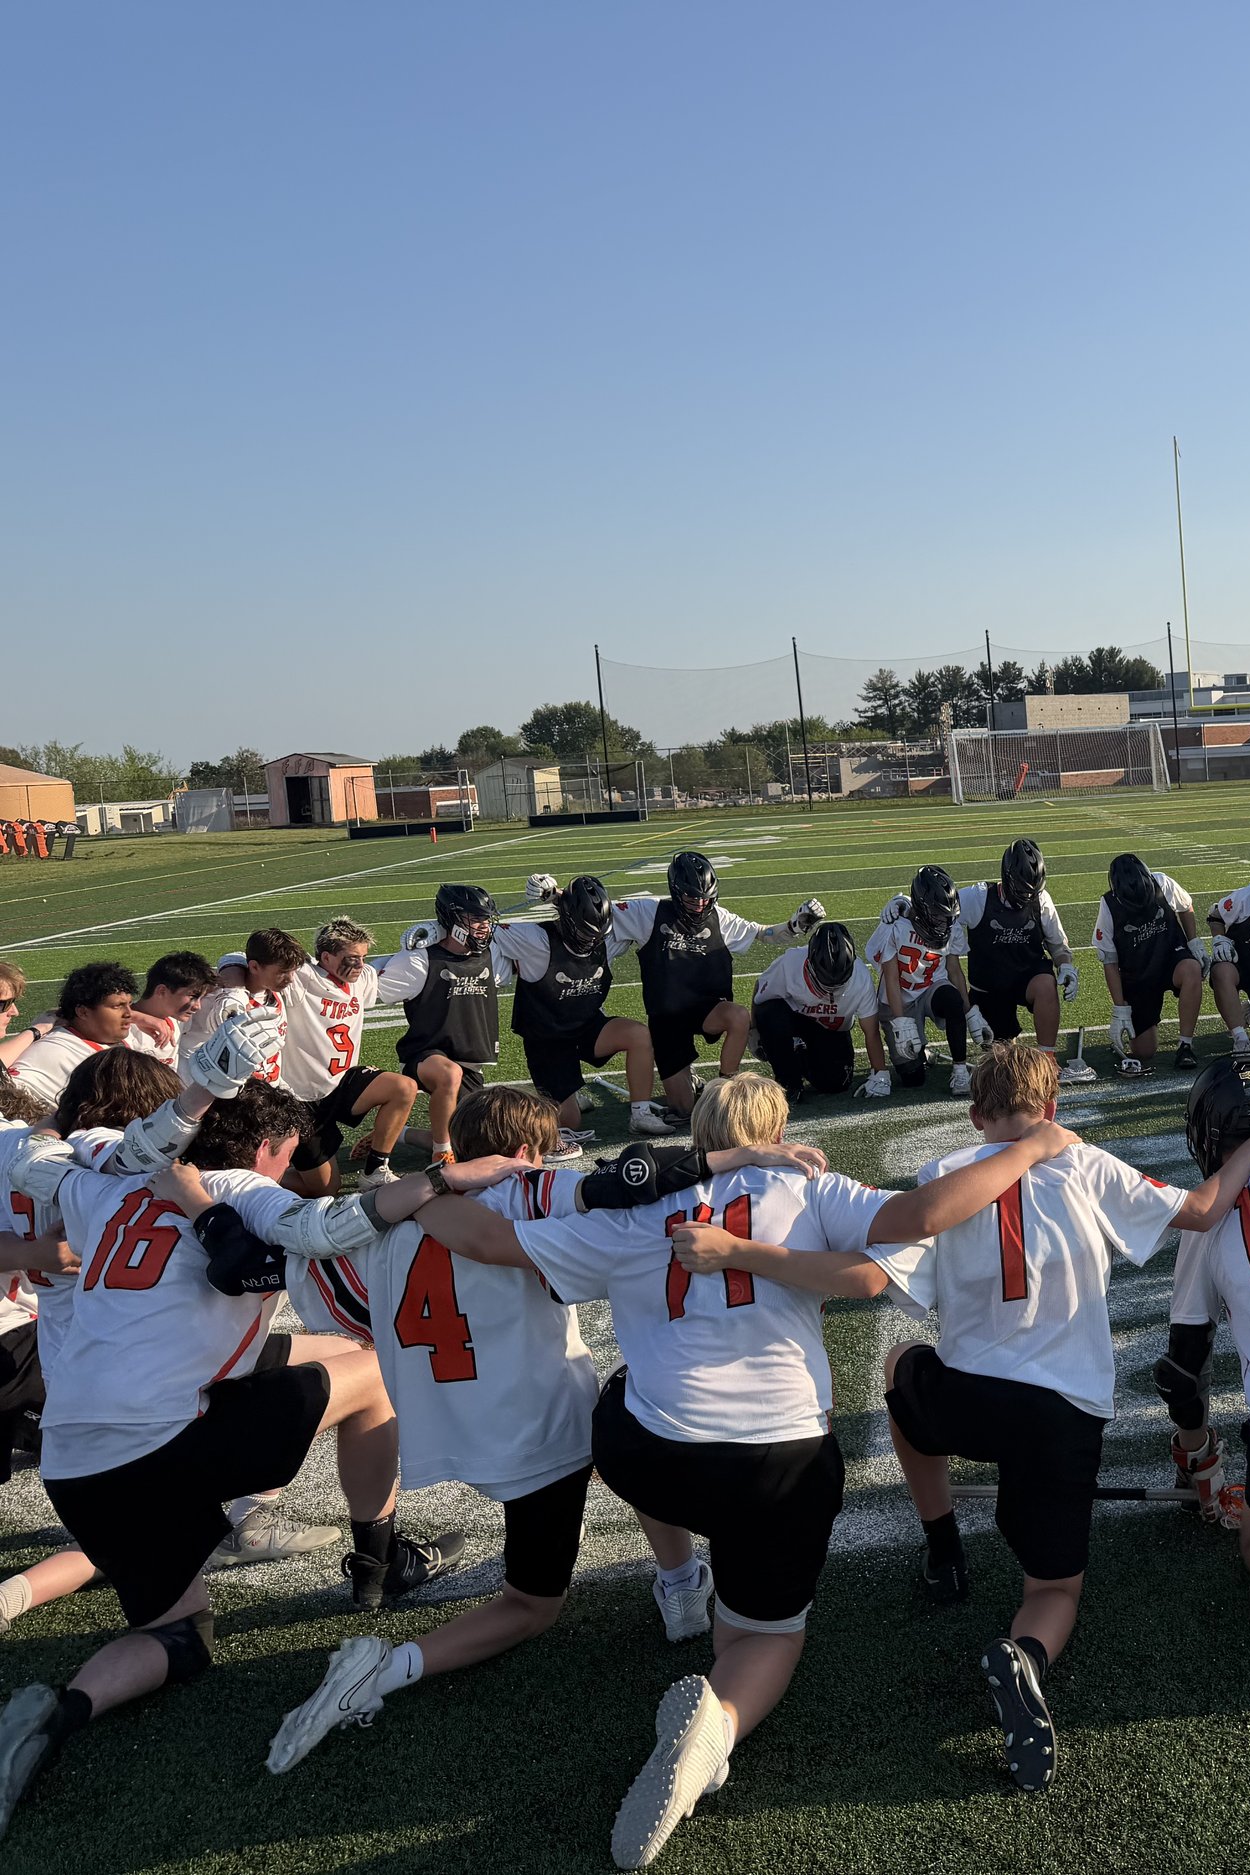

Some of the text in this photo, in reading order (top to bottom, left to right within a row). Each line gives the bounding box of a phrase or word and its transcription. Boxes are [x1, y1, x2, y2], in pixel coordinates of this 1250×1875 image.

[326, 1023, 354, 1077] 9
[84, 1187, 182, 1292] 16
[241, 1274, 281, 1289] BURN
[394, 1233, 478, 1383] 4
